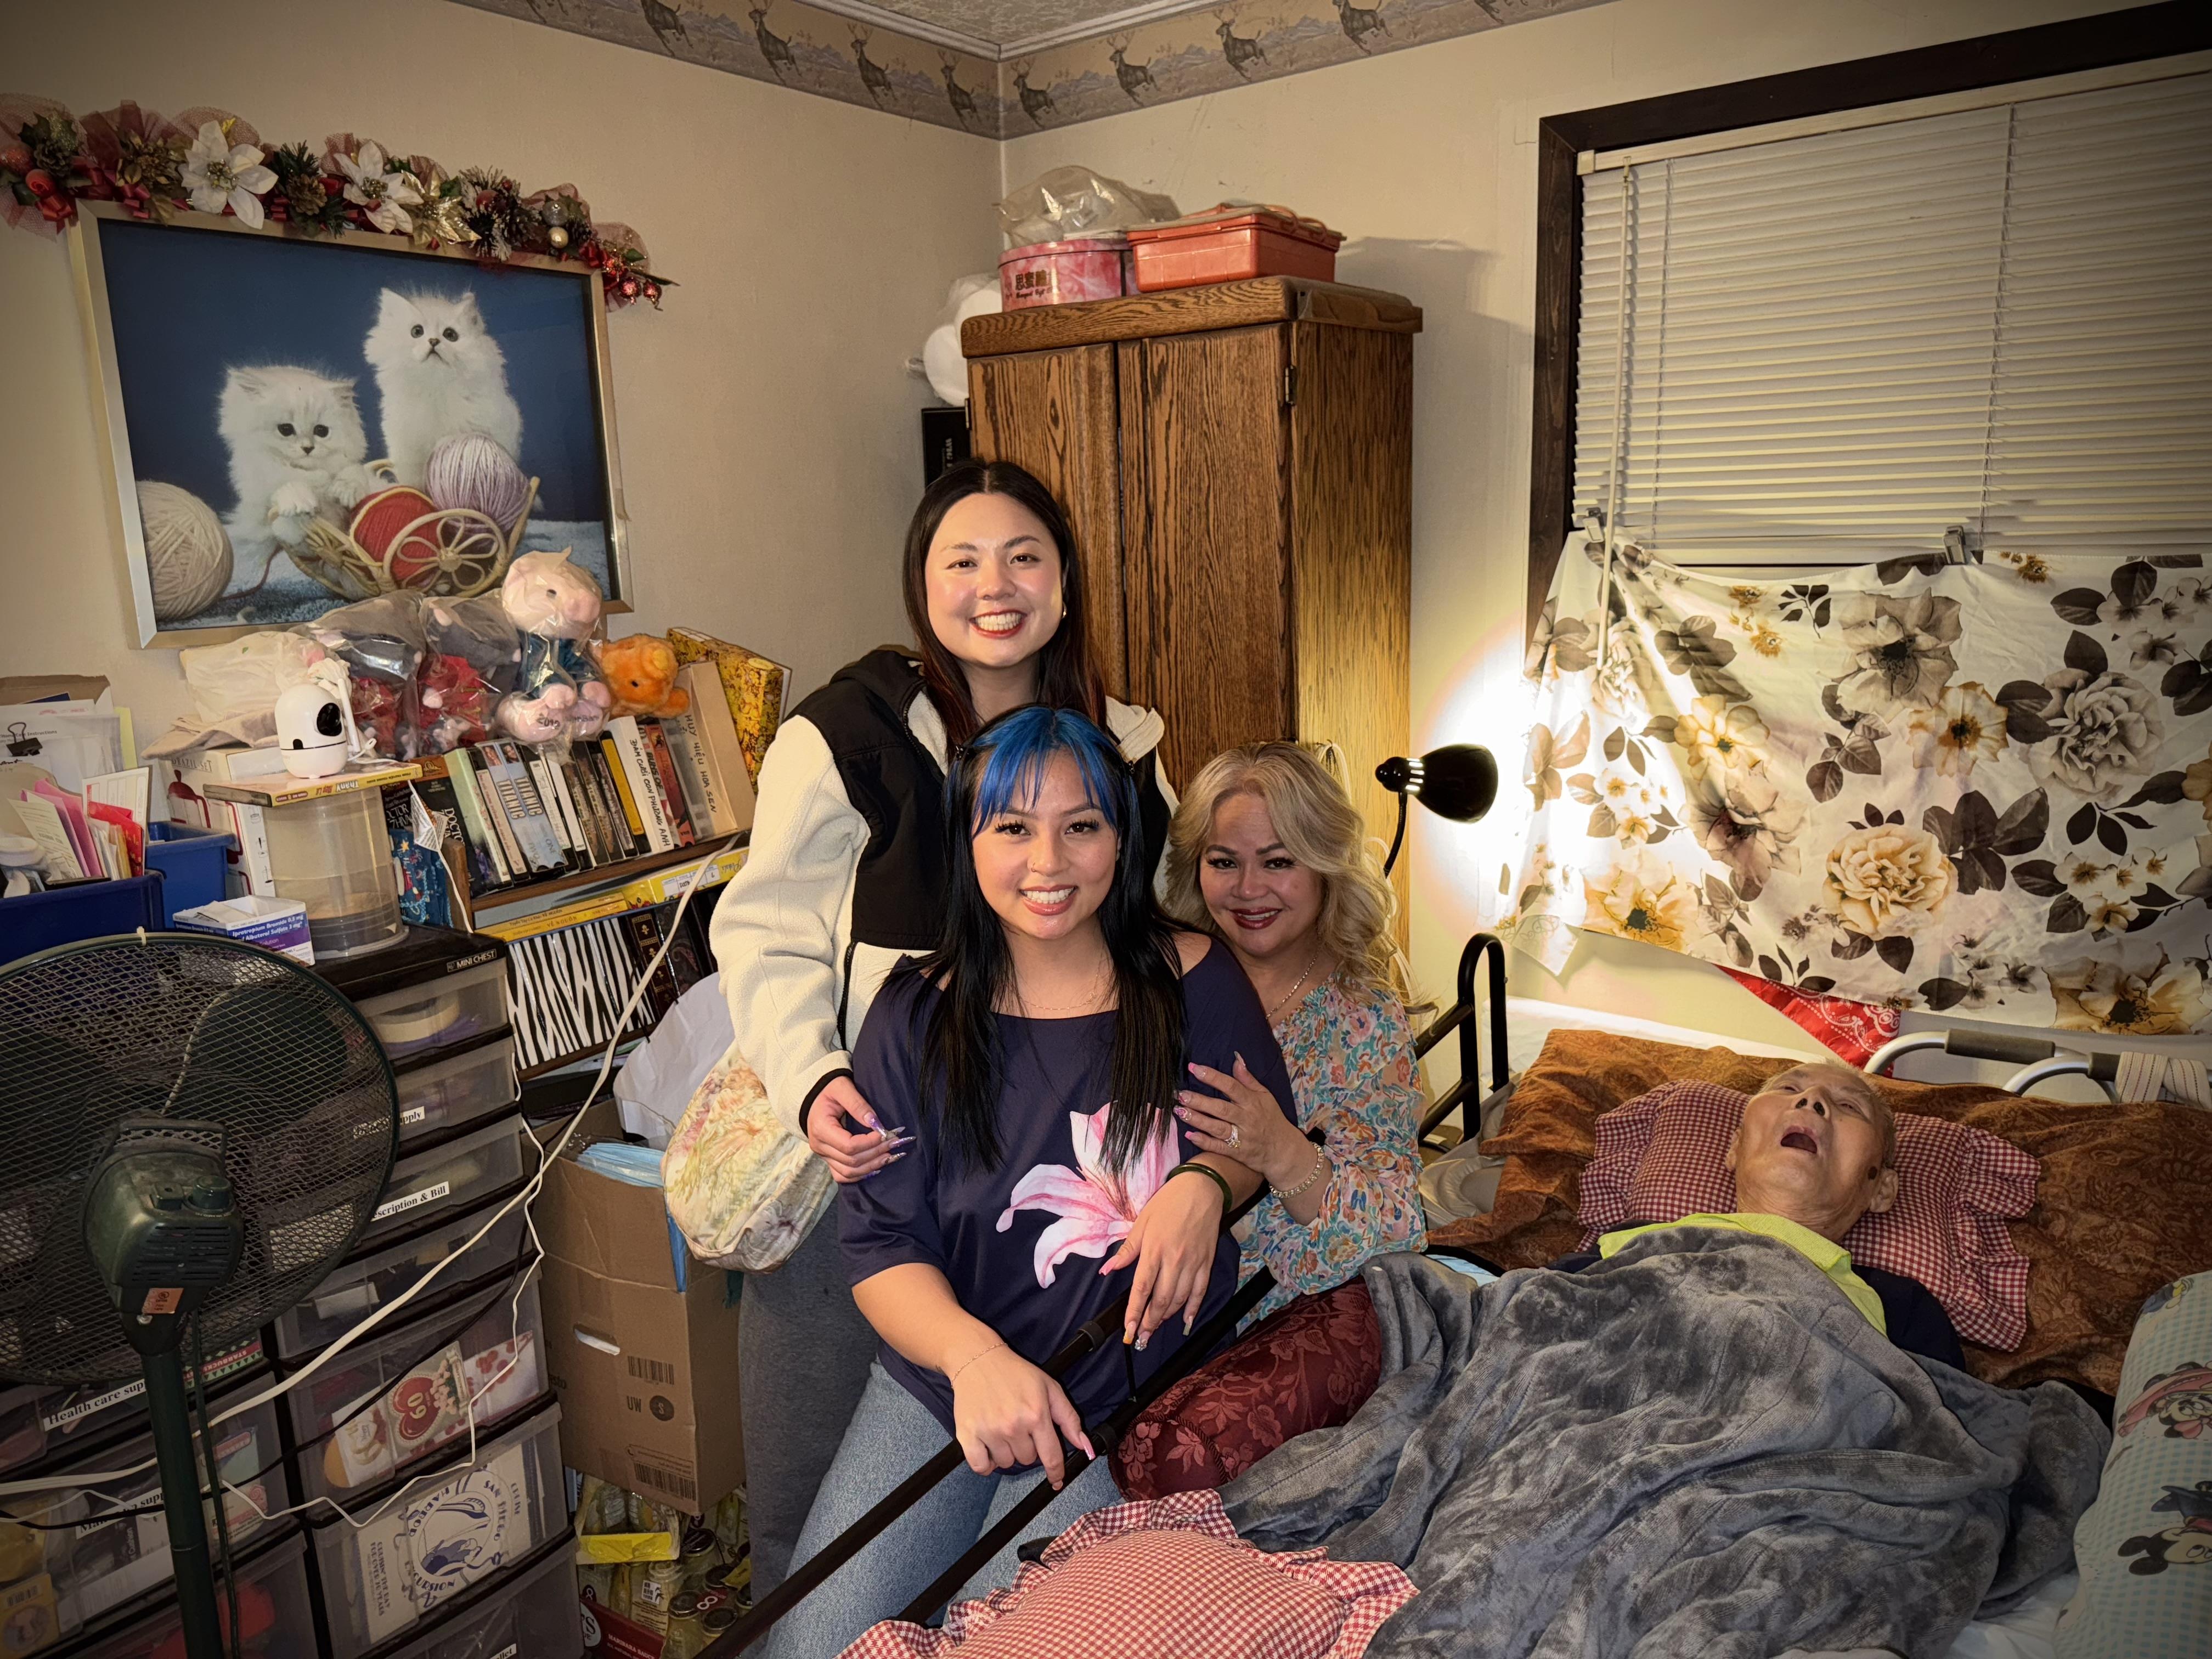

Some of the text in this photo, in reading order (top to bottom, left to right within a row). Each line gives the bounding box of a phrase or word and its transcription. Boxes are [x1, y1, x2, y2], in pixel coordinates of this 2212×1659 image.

[685, 715, 697, 736] HUY
[700, 771, 710, 788] HOA
[706, 791, 716, 812] SEN
[496, 778, 526, 820] TITANIC
[514, 776, 544, 817] TITANIC
[644, 778, 654, 793] CON
[659, 828, 670, 846] ANH
[444, 808, 465, 845] DOCTO
[233, 925, 266, 938] Ipratropium
[266, 919, 287, 929] Bromide
[246, 930, 270, 941] Albuterol
[270, 927, 289, 936] Sulfate
[456, 951, 496, 969] MINI CHEST
[374, 1186, 447, 1218] escription & Bill
[202, 1350, 247, 1372] STARBUCKS
[49, 1381, 145, 1425] Health care sup
[627, 1395, 641, 1413] UW
[140, 1493, 164, 1508] sup
